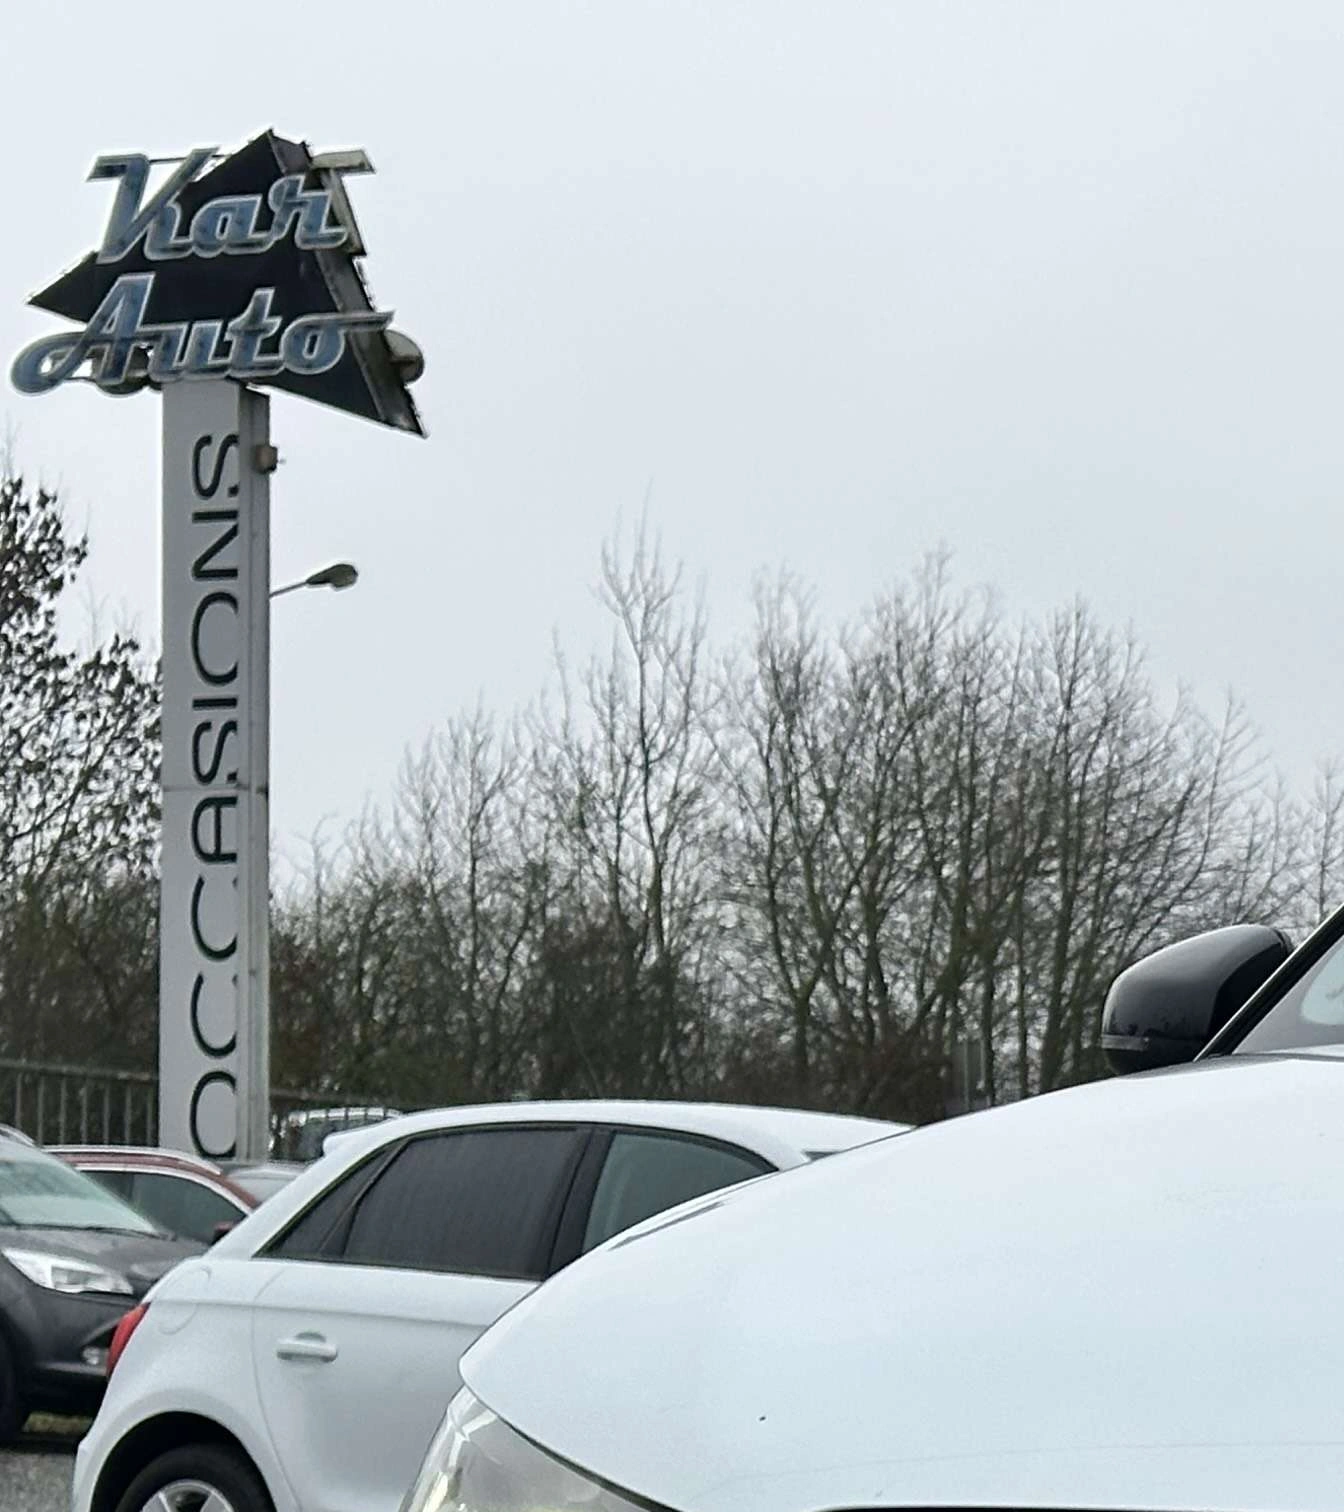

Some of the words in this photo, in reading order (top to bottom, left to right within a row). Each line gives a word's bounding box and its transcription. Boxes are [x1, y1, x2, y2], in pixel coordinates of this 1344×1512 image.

[86, 147, 348, 262] Kar
[10, 272, 394, 396] Auto
[191, 433, 239, 1160] OCCASIONS
